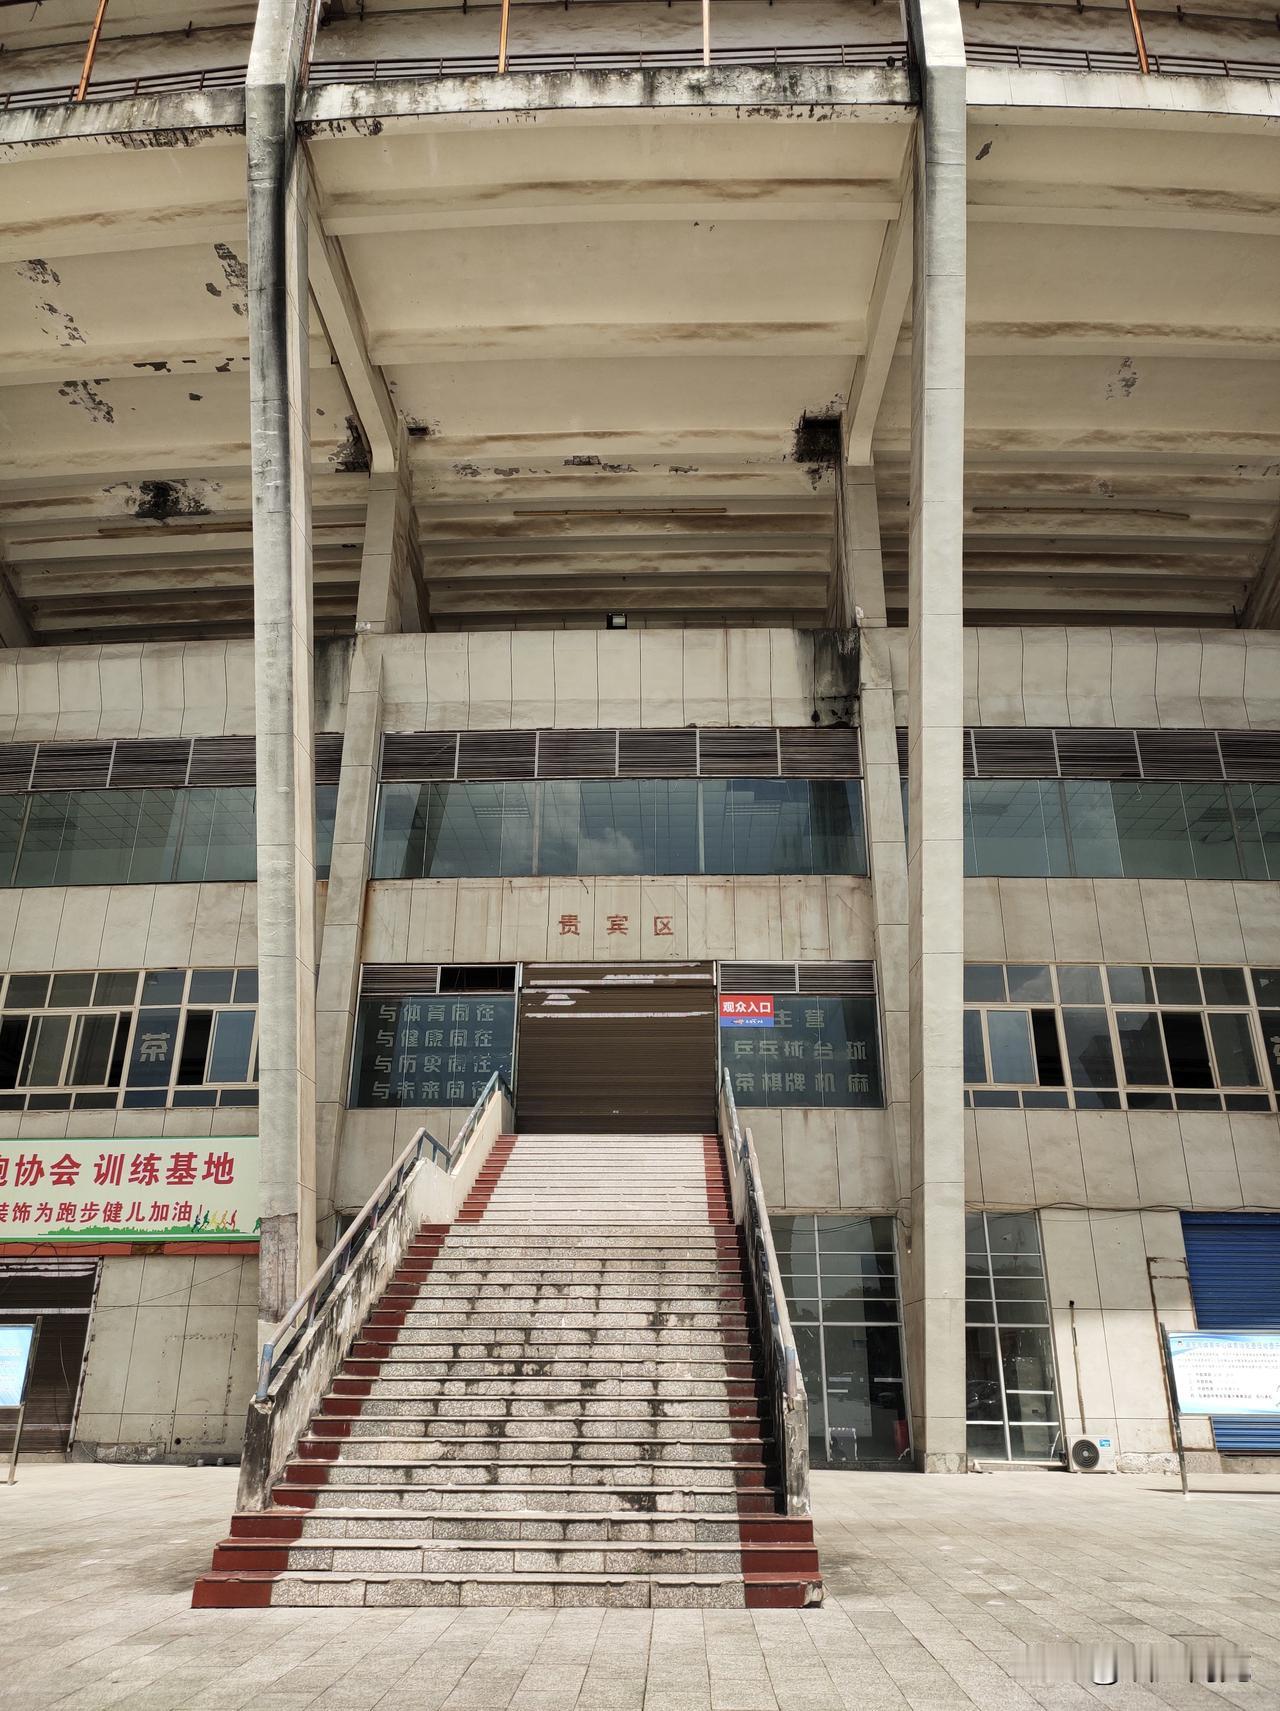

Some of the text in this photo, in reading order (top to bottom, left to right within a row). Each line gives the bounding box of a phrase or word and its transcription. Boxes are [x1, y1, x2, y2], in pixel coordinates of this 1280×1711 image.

[558, 914, 674, 936] 贵宾区
[379, 1004, 494, 1021] 与体育同在
[722, 1001, 771, 1013] 观众入口
[774, 1009, 824, 1028] 主营
[140, 1032, 170, 1062] 茶
[376, 1028, 493, 1047] 与健康同在
[374, 1054, 492, 1073] 与历史同在
